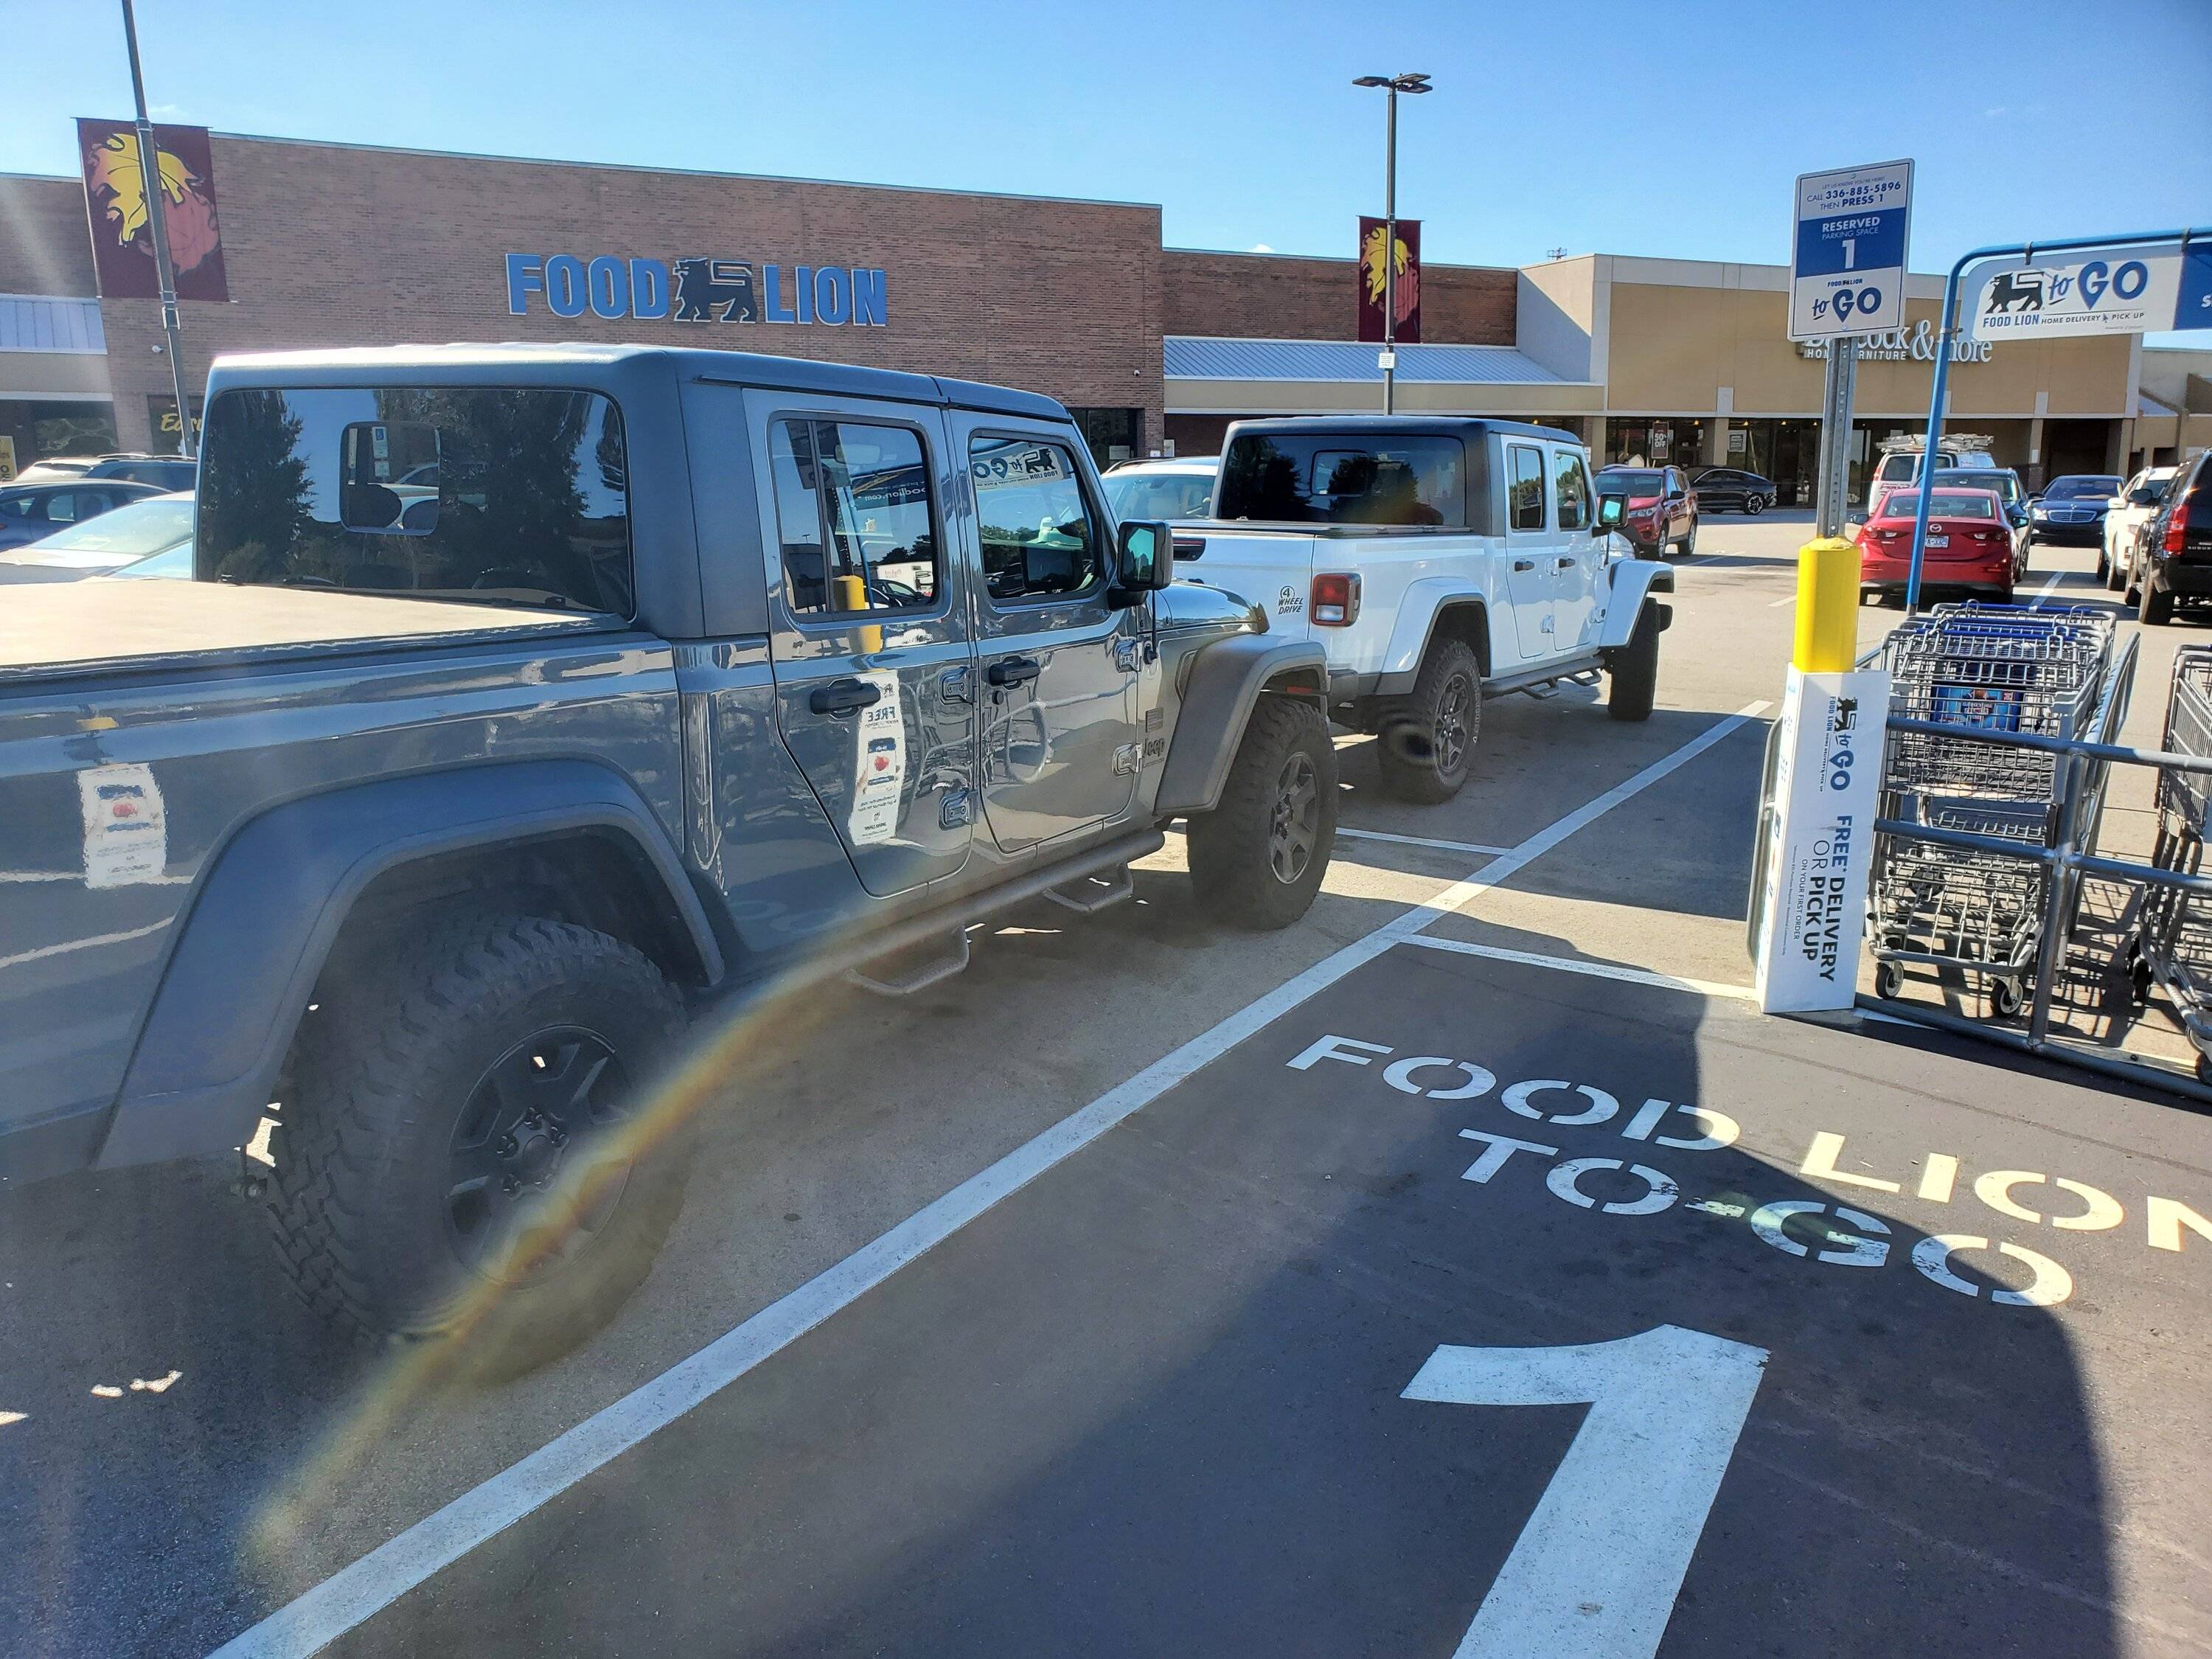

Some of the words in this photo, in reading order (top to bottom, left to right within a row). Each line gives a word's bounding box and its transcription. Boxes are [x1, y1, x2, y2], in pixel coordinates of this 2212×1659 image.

[1820, 202, 1840, 211] THEN
[1842, 195, 1874, 208] PRESS
[1878, 193, 1883, 203] 1
[1825, 181, 1902, 200] 336-885-5896
[1822, 217, 1880, 233] RESERVED
[1822, 229, 1854, 240] PARKING
[1855, 227, 1879, 237] SPACE
[1842, 238, 1855, 269] 1
[505, 253, 669, 320] FOOD
[762, 264, 888, 327] LION
[1827, 279, 1841, 288] FOOD
[2048, 274, 2075, 302] to
[2078, 261, 2149, 311] GO
[1812, 298, 1830, 318] to
[1832, 287, 1882, 323] GO
[1983, 316, 2011, 328] FOOD
[2014, 314, 2039, 327] LION
[2065, 315, 2101, 324] DELIVERY
[1912, 319, 1935, 361] &
[1278, 597, 1304, 606] WHEEL
[1278, 605, 1303, 615] DRIVE
[1838, 734, 1852, 748] to
[1829, 750, 1854, 791] GO
[1801, 858, 1808, 872] ON
[1811, 839, 1830, 870] OR
[1799, 871, 1807, 894] YOUR
[1797, 894, 1805, 914] FIRST
[1805, 876, 1826, 926] PICK
[1793, 914, 1802, 940] ORDER
[1819, 877, 1846, 983] DELIVERY
[1802, 931, 1820, 961] UP
[1286, 1034, 1740, 1151] FOOD
[1399, 1324, 1770, 1659] 1
